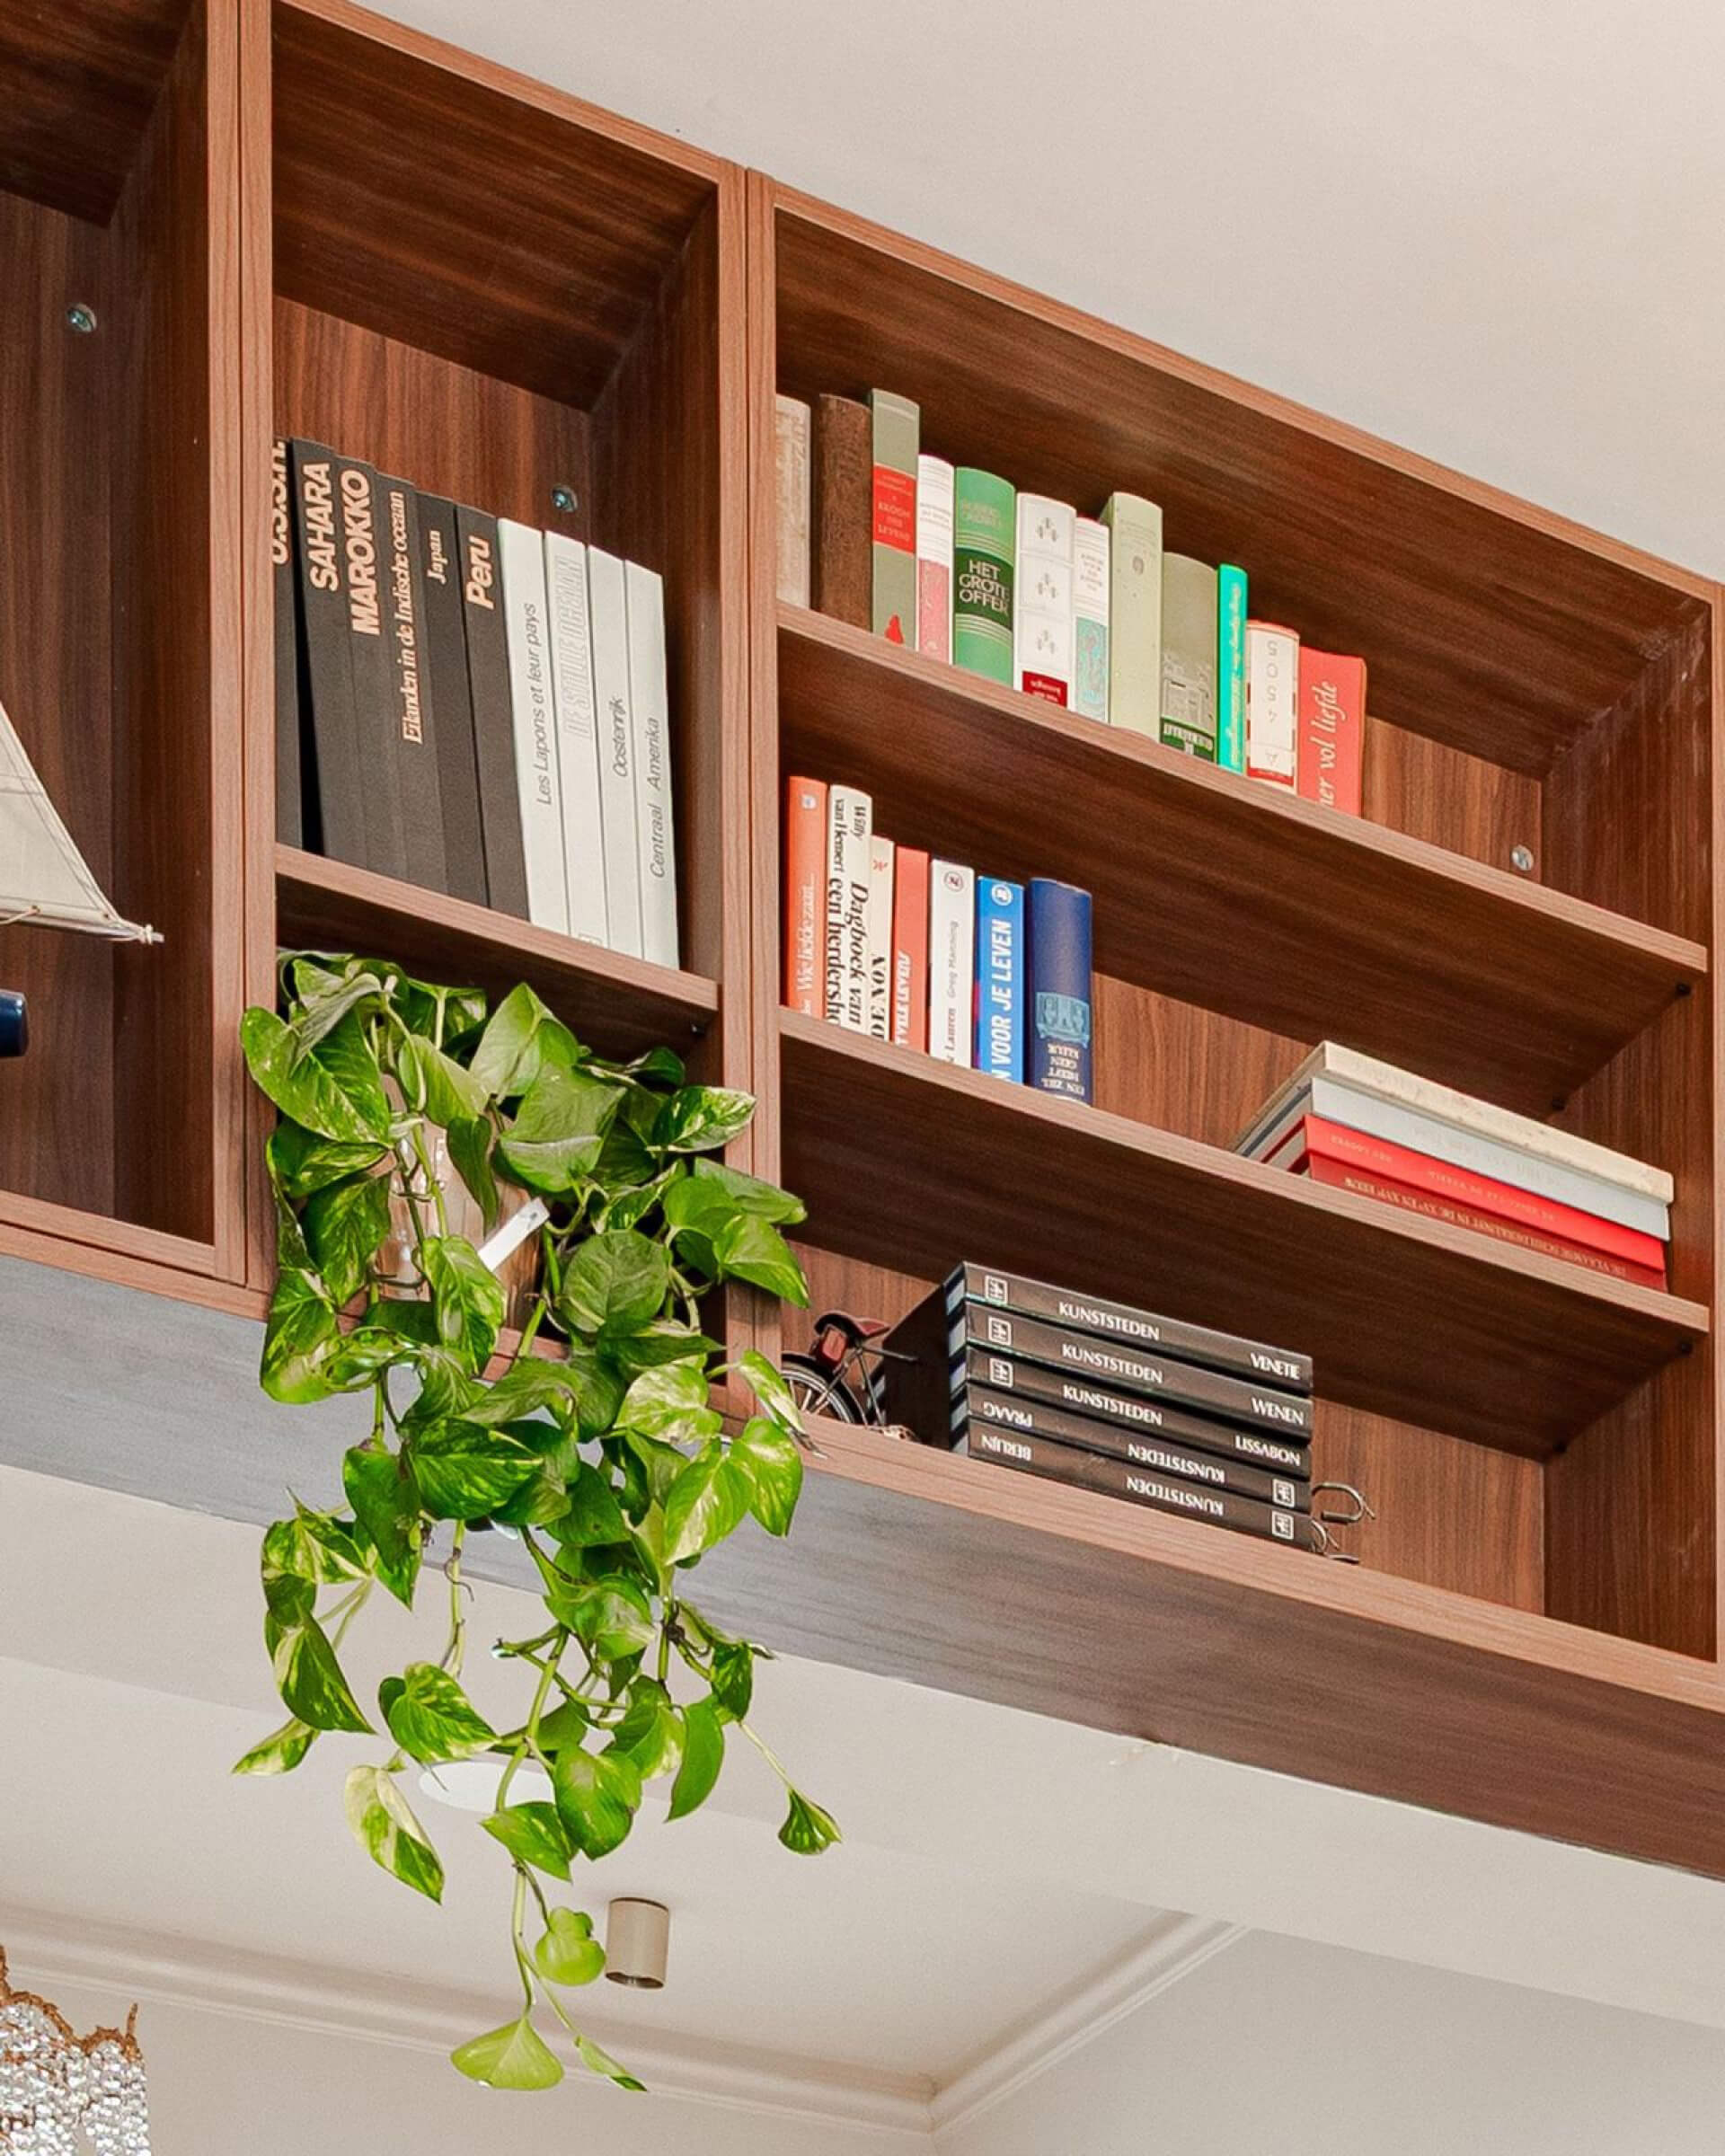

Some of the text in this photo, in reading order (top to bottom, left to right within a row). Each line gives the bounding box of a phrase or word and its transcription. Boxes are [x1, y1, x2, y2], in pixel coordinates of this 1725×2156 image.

[303, 462, 340, 593] SAHARA
[340, 469, 381, 636] MAROKKO
[428, 530, 448, 584] Japan
[465, 535, 495, 610] Peru
[959, 588, 1009, 616] OFFER
[969, 559, 1001, 581] HET
[388, 491, 423, 745] Eilanden in de Indische oceaan
[554, 555, 591, 739] DE STILLE OCEAAN
[522, 603, 553, 806] Les Lapons et leur pays
[608, 695, 629, 778] Oostenrijk
[1311, 681, 1347, 734] liefde
[1309, 737, 1336, 770] vol
[645, 718, 666, 879] Centraal Amerika
[833, 798, 847, 872] van Hemert
[851, 804, 867, 841] Willy
[827, 878, 845, 915] een
[845, 880, 871, 1026] Dagboek van
[992, 918, 1013, 982] LEVEN
[944, 1008, 957, 1051] Lauren
[992, 985, 1013, 1012] JE
[992, 1014, 1013, 1065] VOOR
[1058, 1301, 1161, 1341] KUNSTSTEDEN
[1062, 1343, 1305, 1427] KUNSTSTEDEN WENEN
[983, 1401, 1226, 1484] PRAAG KUNSTSTEDEN
[1063, 1383, 1302, 1468] KUNSTSTEDEN LISSABON
[981, 1434, 1225, 1517] BERLIJN KUNSTSTEDEN
